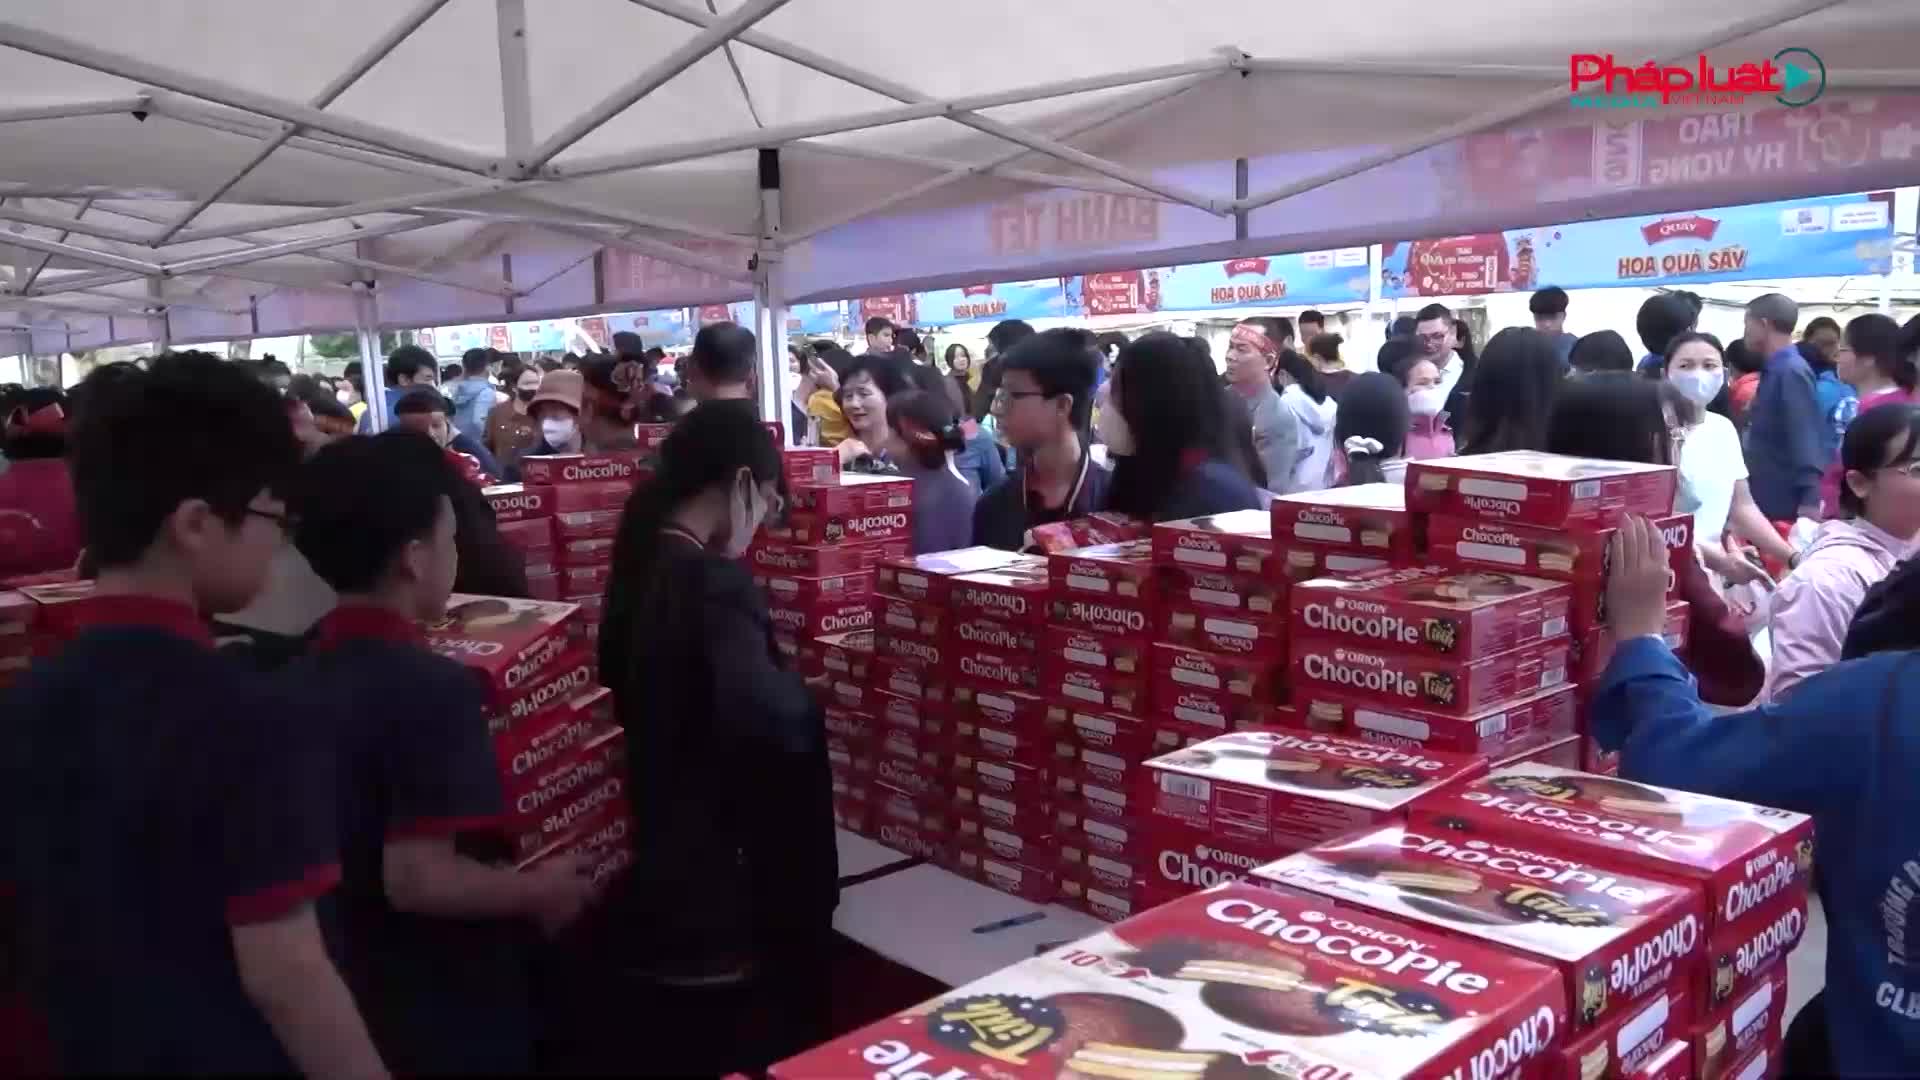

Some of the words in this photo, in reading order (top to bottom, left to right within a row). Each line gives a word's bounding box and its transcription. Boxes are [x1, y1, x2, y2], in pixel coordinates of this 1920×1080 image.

[1618, 256, 1656, 277] HOA
[1211, 287, 1234, 302] HOA
[563, 464, 631, 481] ChocoPie
[848, 513, 907, 531] ChocoPie
[1463, 528, 1521, 545] ChocoPie
[1072, 602, 1146, 631] ChocoPie
[1346, 600, 1387, 614] ORION
[960, 623, 1017, 649] ChocoPie
[1303, 603, 1419, 644] ChocoPie
[960, 656, 1020, 685] ChocoPie
[1346, 651, 1385, 667] ORION
[1303, 654, 1418, 697] ChocoPie
[1461, 791, 1714, 850] ChocoPie
[1209, 850, 1265, 869] ORION
[1401, 832, 1648, 902] ChocoPie
[1725, 858, 1796, 923] ChocoPie
[1206, 899, 1489, 994] ChocoPie
[1330, 917, 1428, 951] ORION
[1736, 908, 1802, 976] ChocoPie
[1061, 949, 1104, 967] 10
[1611, 914, 1697, 994] ChocoPie
